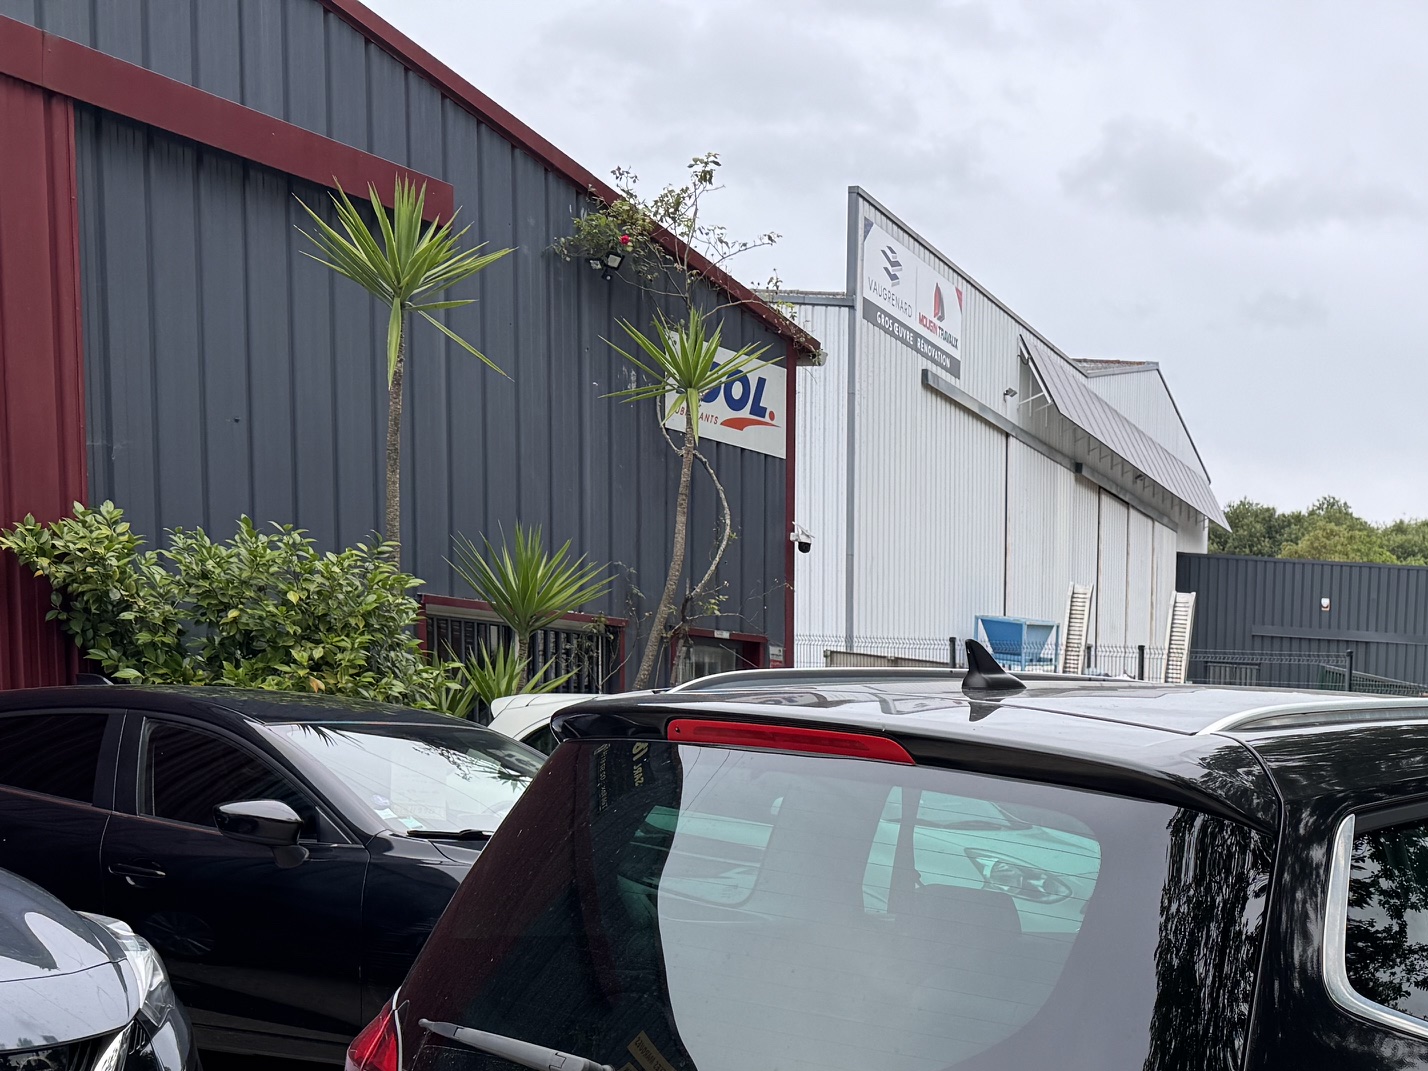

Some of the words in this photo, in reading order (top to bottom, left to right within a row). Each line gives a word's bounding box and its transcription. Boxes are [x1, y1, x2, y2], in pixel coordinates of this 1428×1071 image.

[868, 276, 913, 318] VAUGRENARD
[876, 311, 893, 331] GROS
[916, 337, 951, 369] RÉNOVATION
